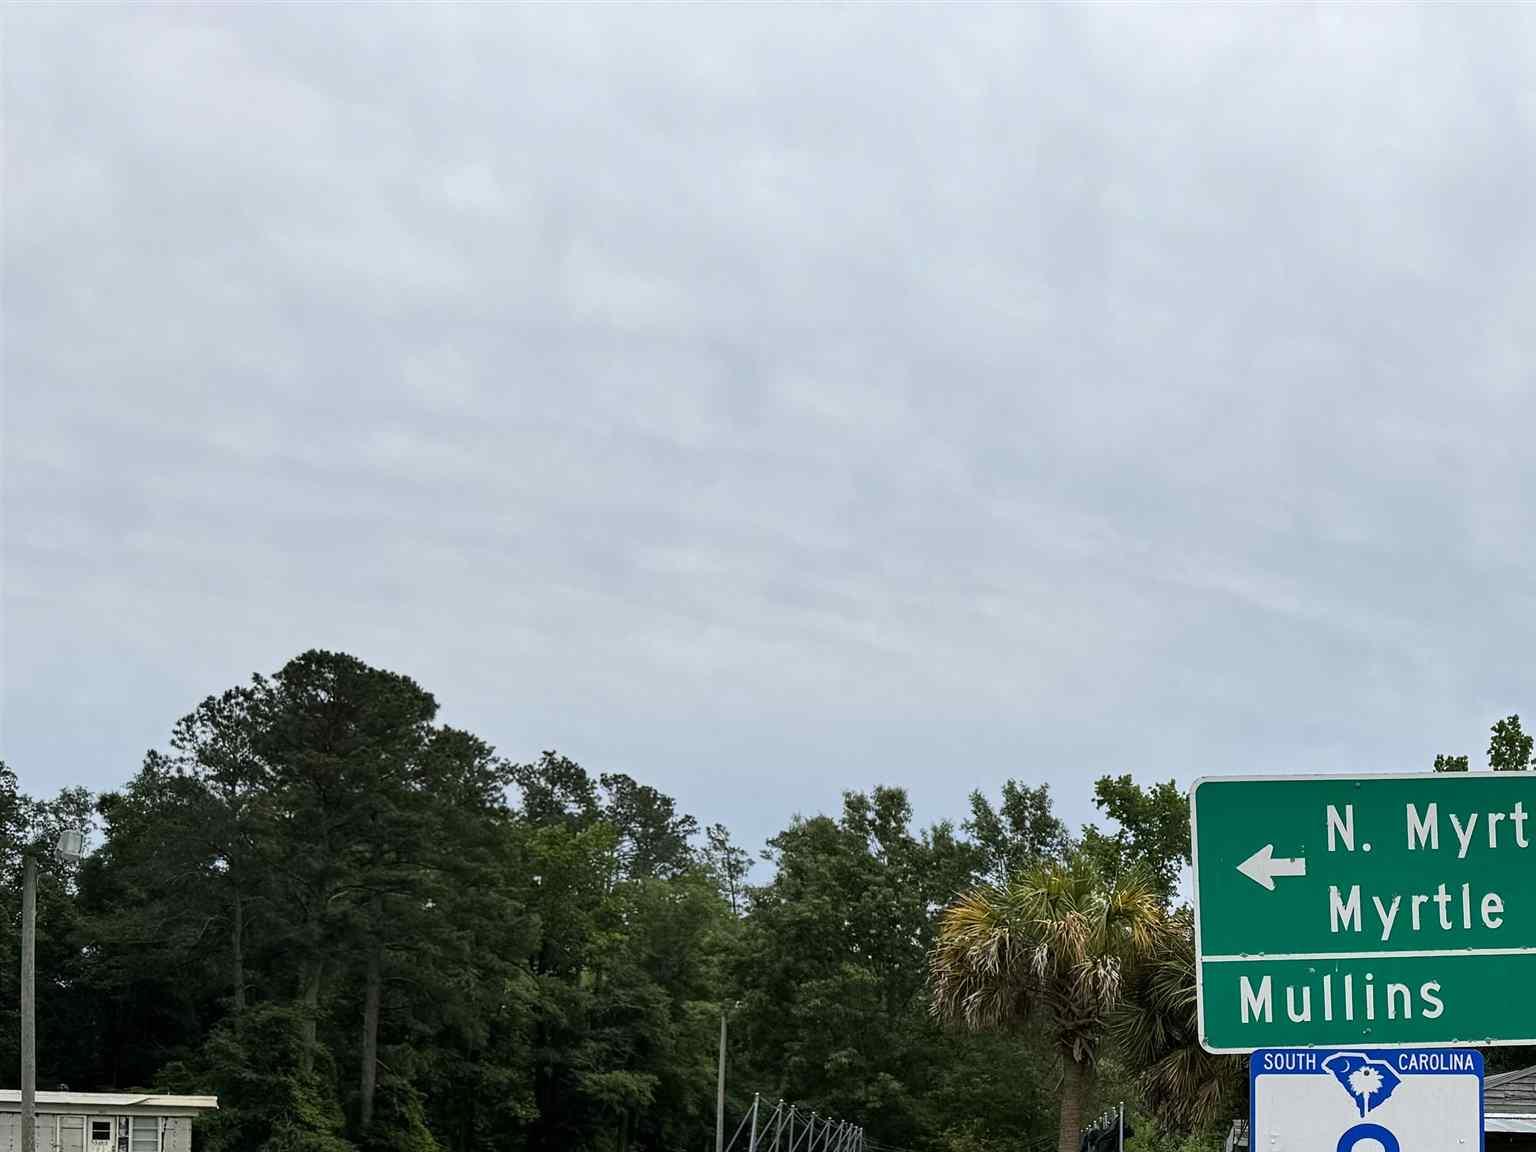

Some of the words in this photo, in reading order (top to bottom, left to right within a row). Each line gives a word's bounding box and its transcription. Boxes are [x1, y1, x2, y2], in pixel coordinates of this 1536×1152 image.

[1326, 804, 1372, 853] N.
[1329, 882, 1505, 941] Myrtle
[1240, 974, 1445, 1024] Mullins
[1263, 1053, 1316, 1071] SOUTH
[1398, 1053, 1474, 1071] CAROLINA
